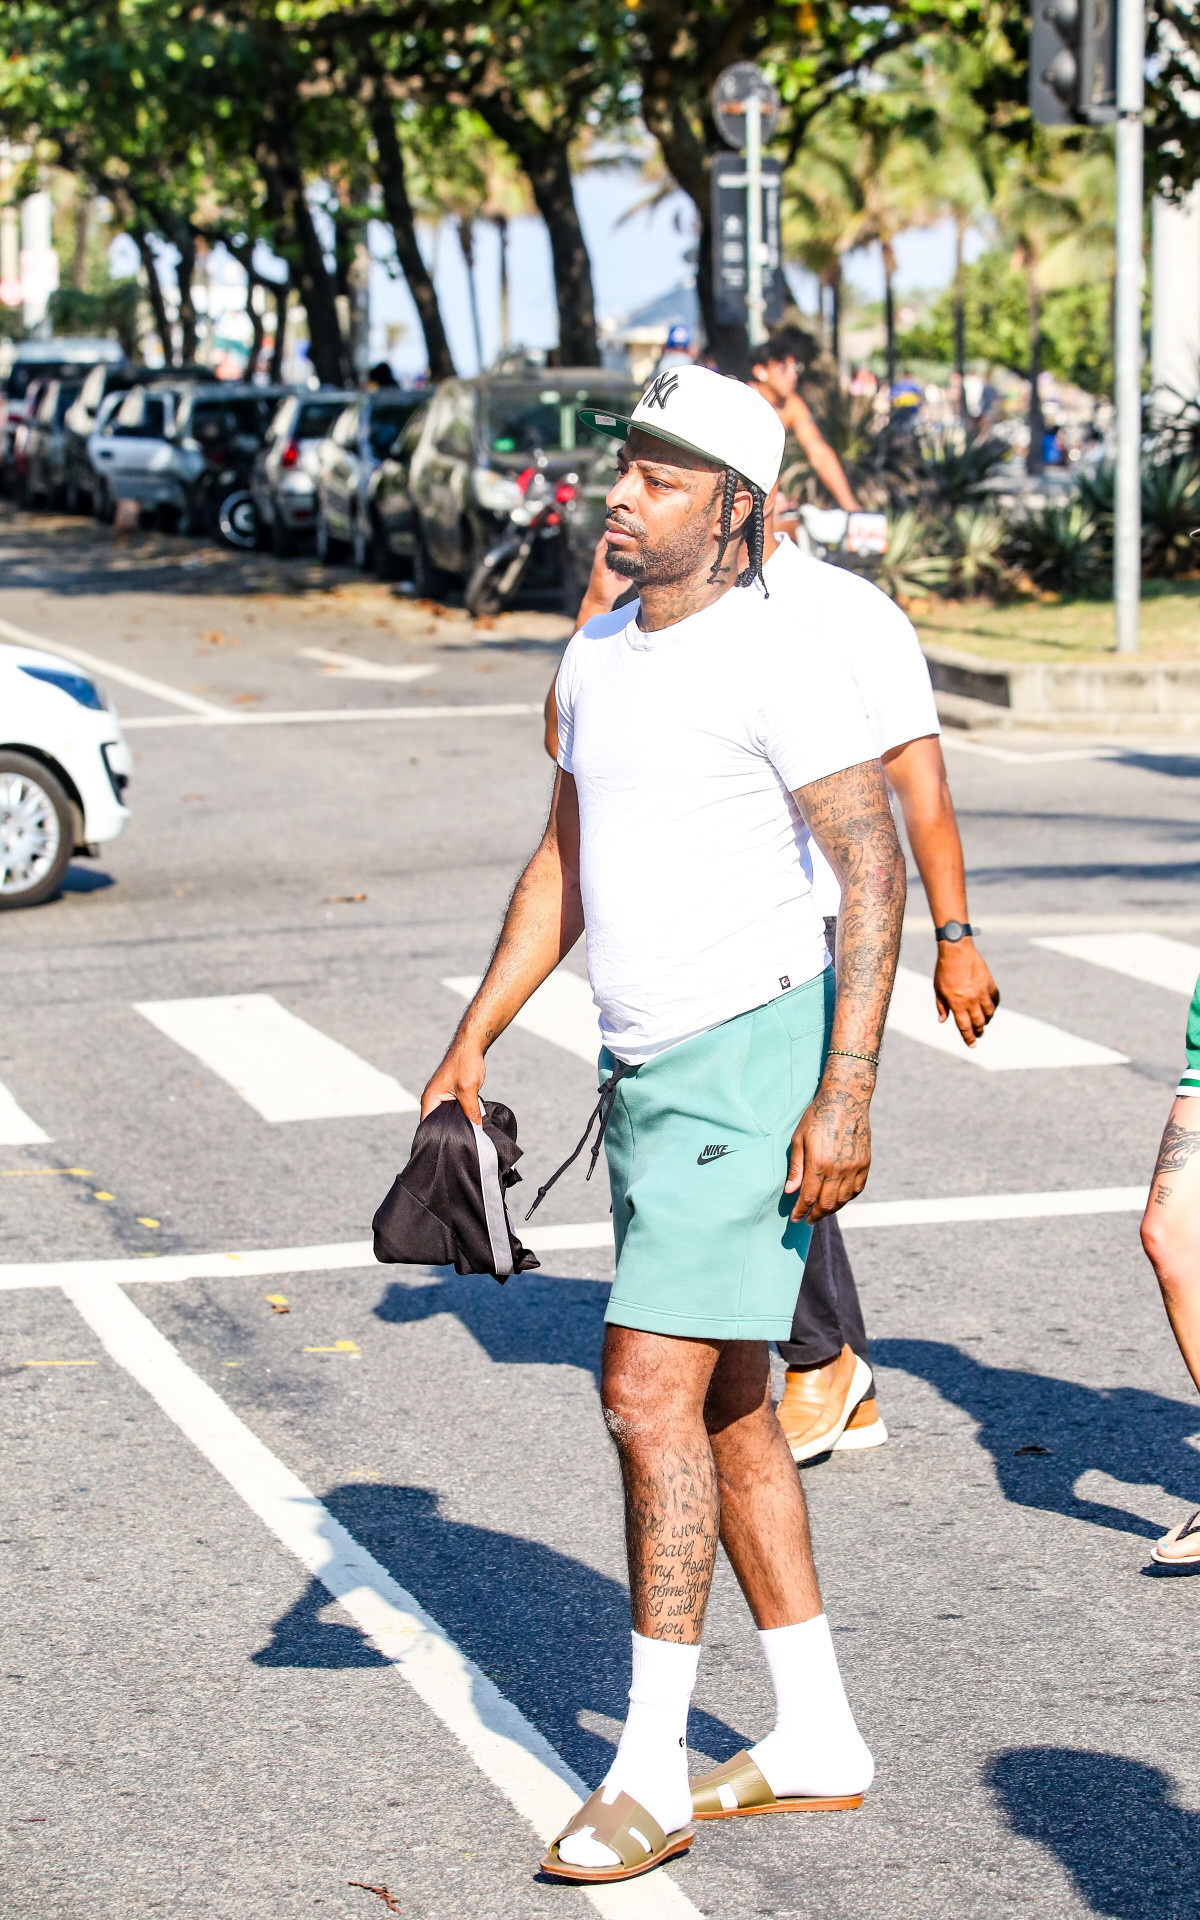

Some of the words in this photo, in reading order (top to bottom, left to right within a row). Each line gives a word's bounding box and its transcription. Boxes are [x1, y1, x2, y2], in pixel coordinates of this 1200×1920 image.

[702, 1144, 729, 1157] NIKE
[648, 1540, 695, 1561] pain
[649, 1563, 675, 1587] my
[667, 1594, 697, 1617] will
[652, 1621, 685, 1640] you
